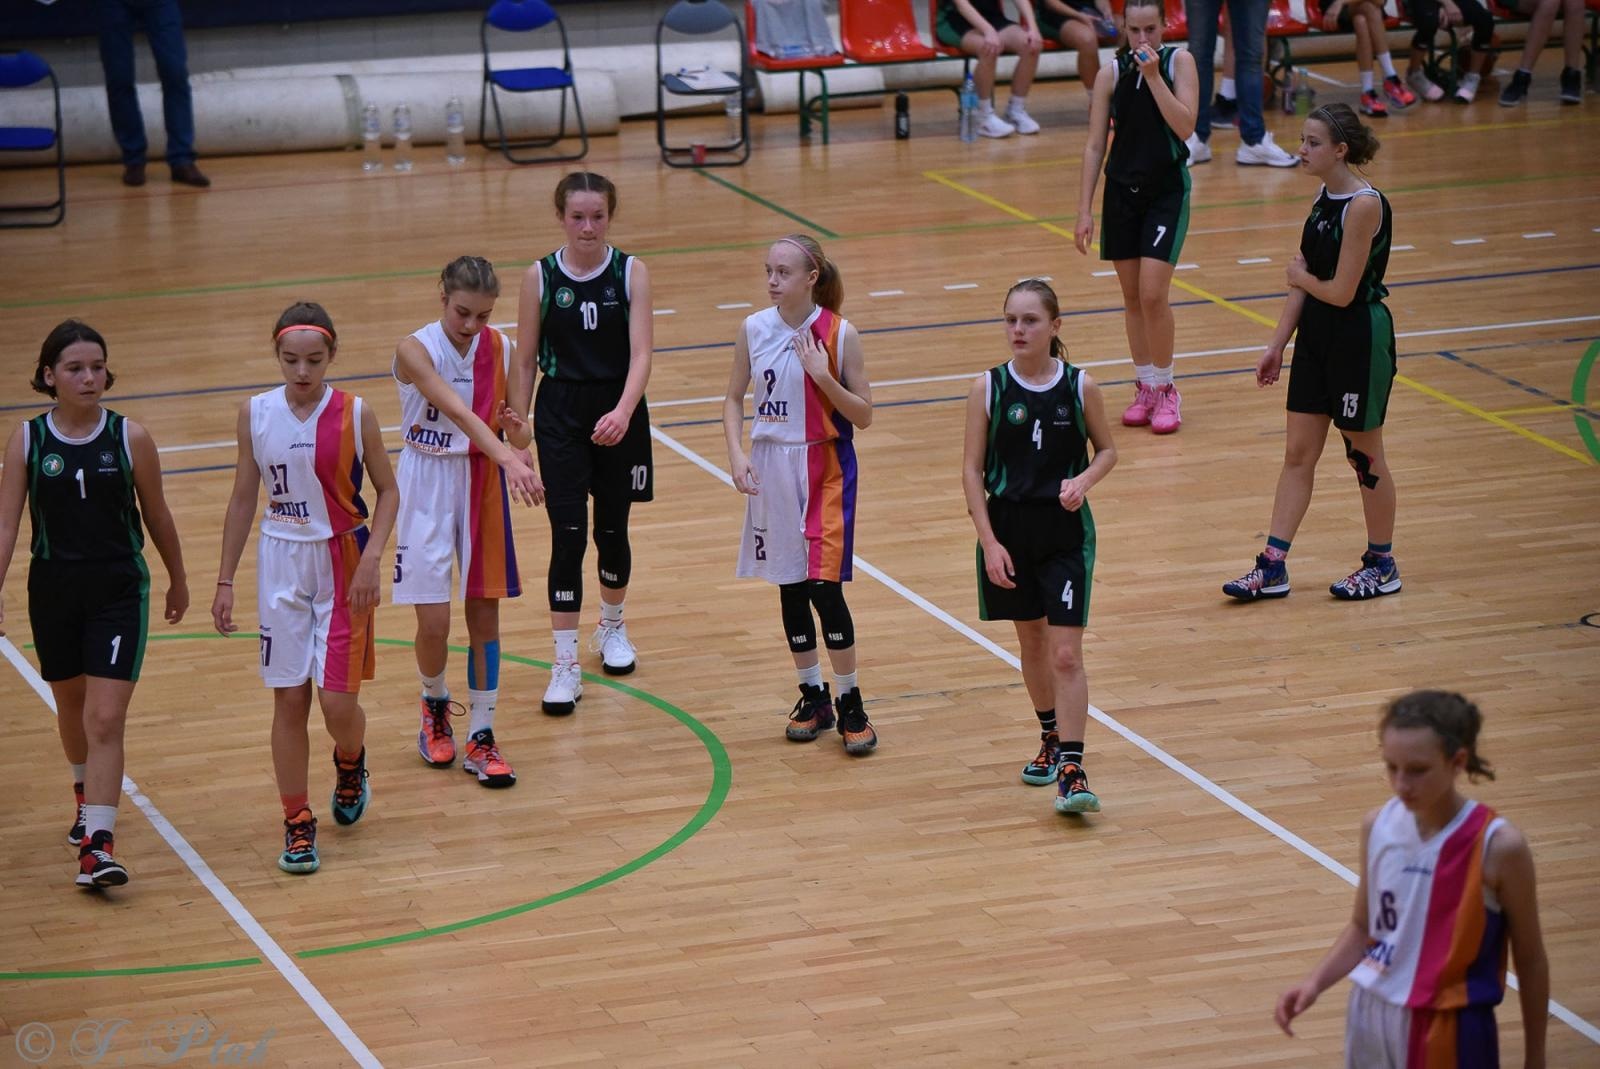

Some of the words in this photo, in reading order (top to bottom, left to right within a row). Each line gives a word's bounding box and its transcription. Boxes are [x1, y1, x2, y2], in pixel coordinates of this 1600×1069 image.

[1153, 225, 1167, 247] 7
[580, 301, 598, 330] 10
[1342, 392, 1359, 418] 13
[406, 426, 453, 448] MINI
[1032, 419, 1042, 450] 4
[75, 468, 87, 499] 1
[630, 464, 648, 491] 10
[754, 534, 767, 560] 2
[605, 572, 618, 582] NBA
[561, 590, 575, 601] NBA
[1061, 580, 1073, 609] 4
[110, 635, 122, 665] 1
